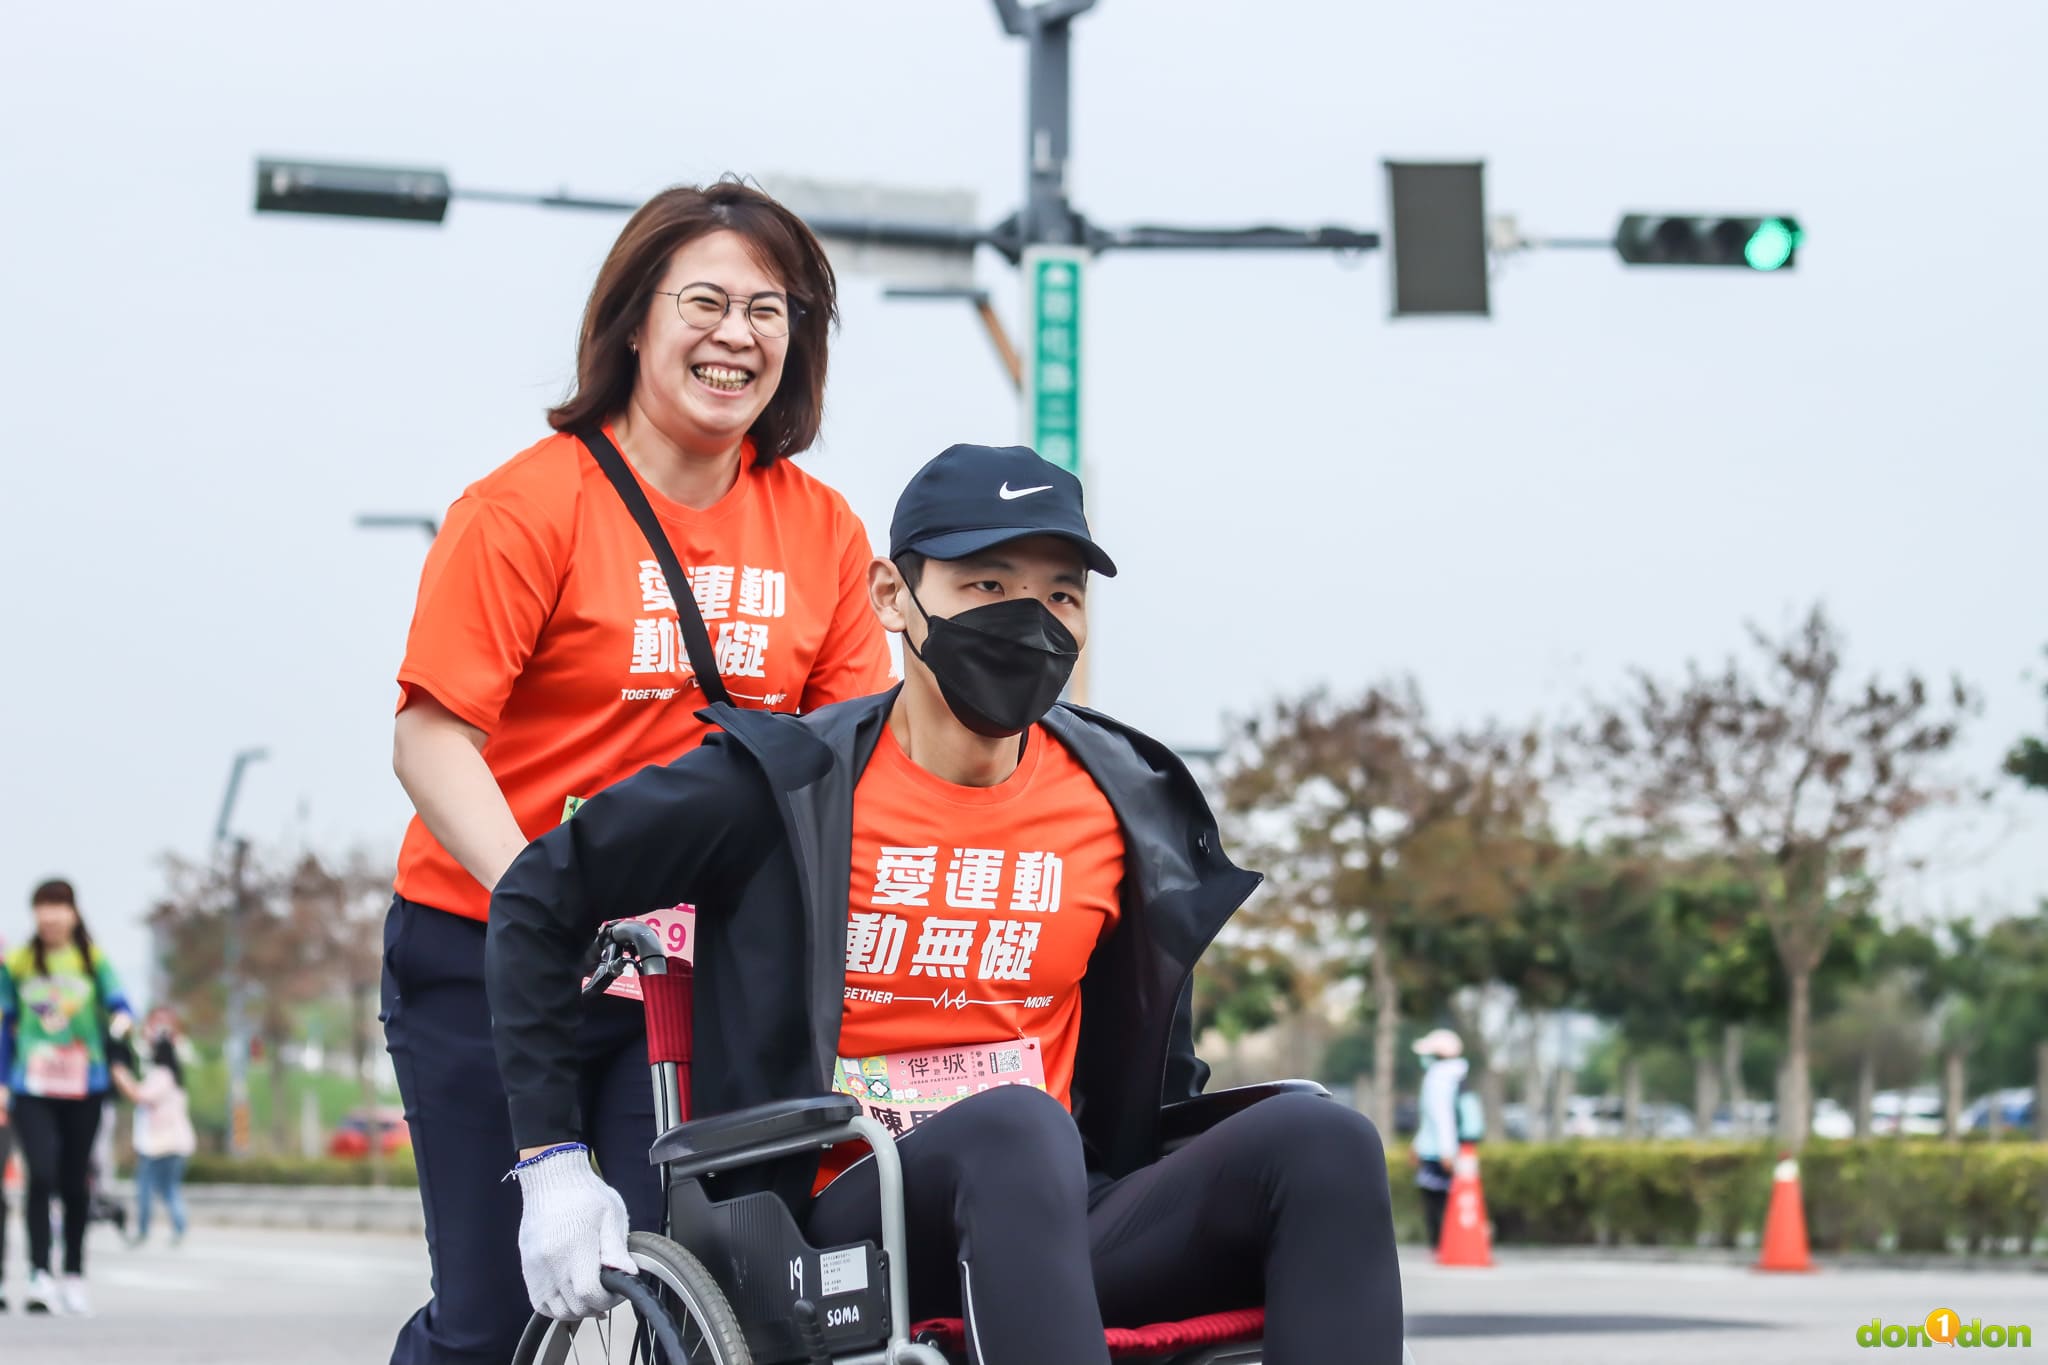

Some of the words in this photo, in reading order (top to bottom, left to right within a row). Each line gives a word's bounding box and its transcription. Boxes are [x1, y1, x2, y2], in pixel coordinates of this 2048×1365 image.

[629, 617, 769, 678] 動礙
[621, 687, 674, 701] TOGETHER
[871, 846, 1063, 913] 愛運動
[845, 912, 1042, 981] 動無礙
[1024, 995, 1054, 1009] MOVE
[827, 1305, 860, 1328] SOMA
